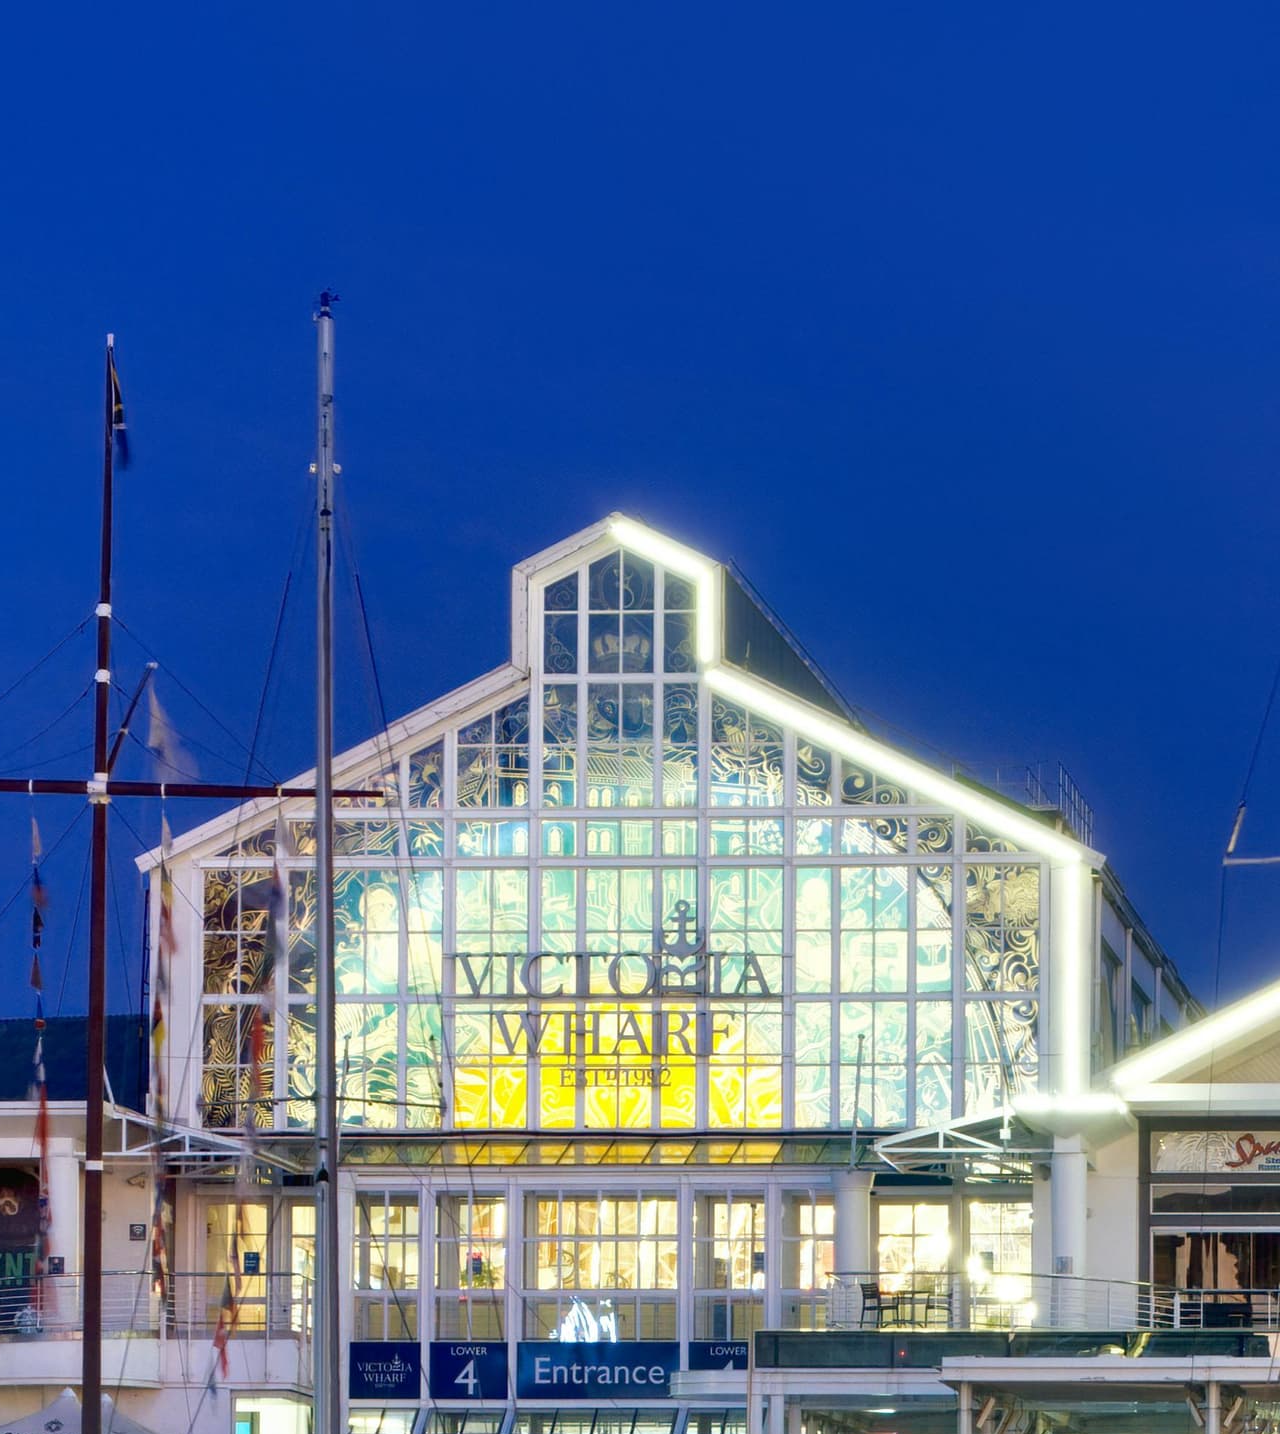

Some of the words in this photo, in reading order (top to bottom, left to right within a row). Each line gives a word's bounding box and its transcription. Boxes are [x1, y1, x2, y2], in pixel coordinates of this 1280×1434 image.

[494, 1010, 735, 1057] WHARF
[450, 1346, 488, 1356] LOWER
[710, 1346, 747, 1356] LOWER
[363, 1372, 407, 1383] WHARF
[453, 1359, 479, 1396] 4
[533, 1356, 665, 1385] Entrance
